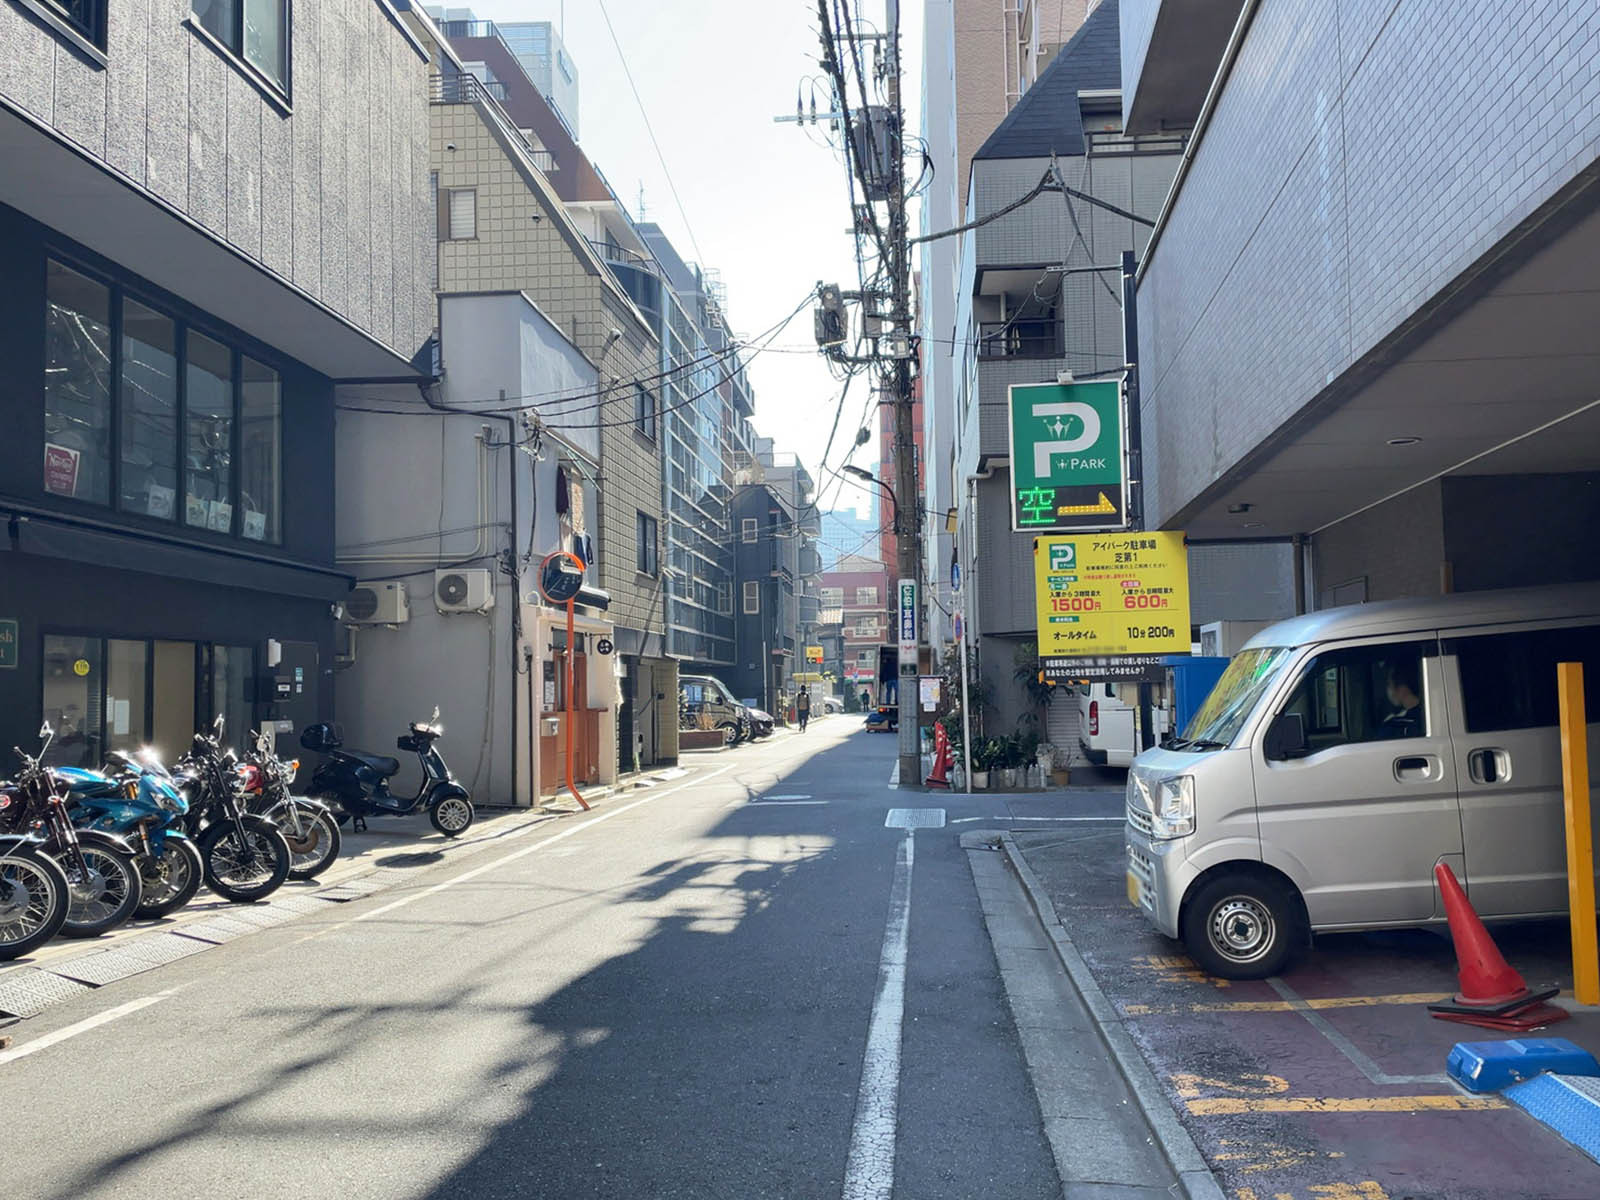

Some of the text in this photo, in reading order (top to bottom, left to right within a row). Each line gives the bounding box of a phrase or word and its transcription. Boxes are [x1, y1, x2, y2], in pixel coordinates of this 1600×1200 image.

[1032, 401, 1101, 479] P
[1070, 457, 1106, 470] PARK
[1019, 486, 1056, 525] 空
[1051, 545, 1073, 570] P
[1051, 597, 1102, 612] 1500円
[1124, 594, 1168, 609] 600円
[1053, 630, 1097, 640] オールタイム
